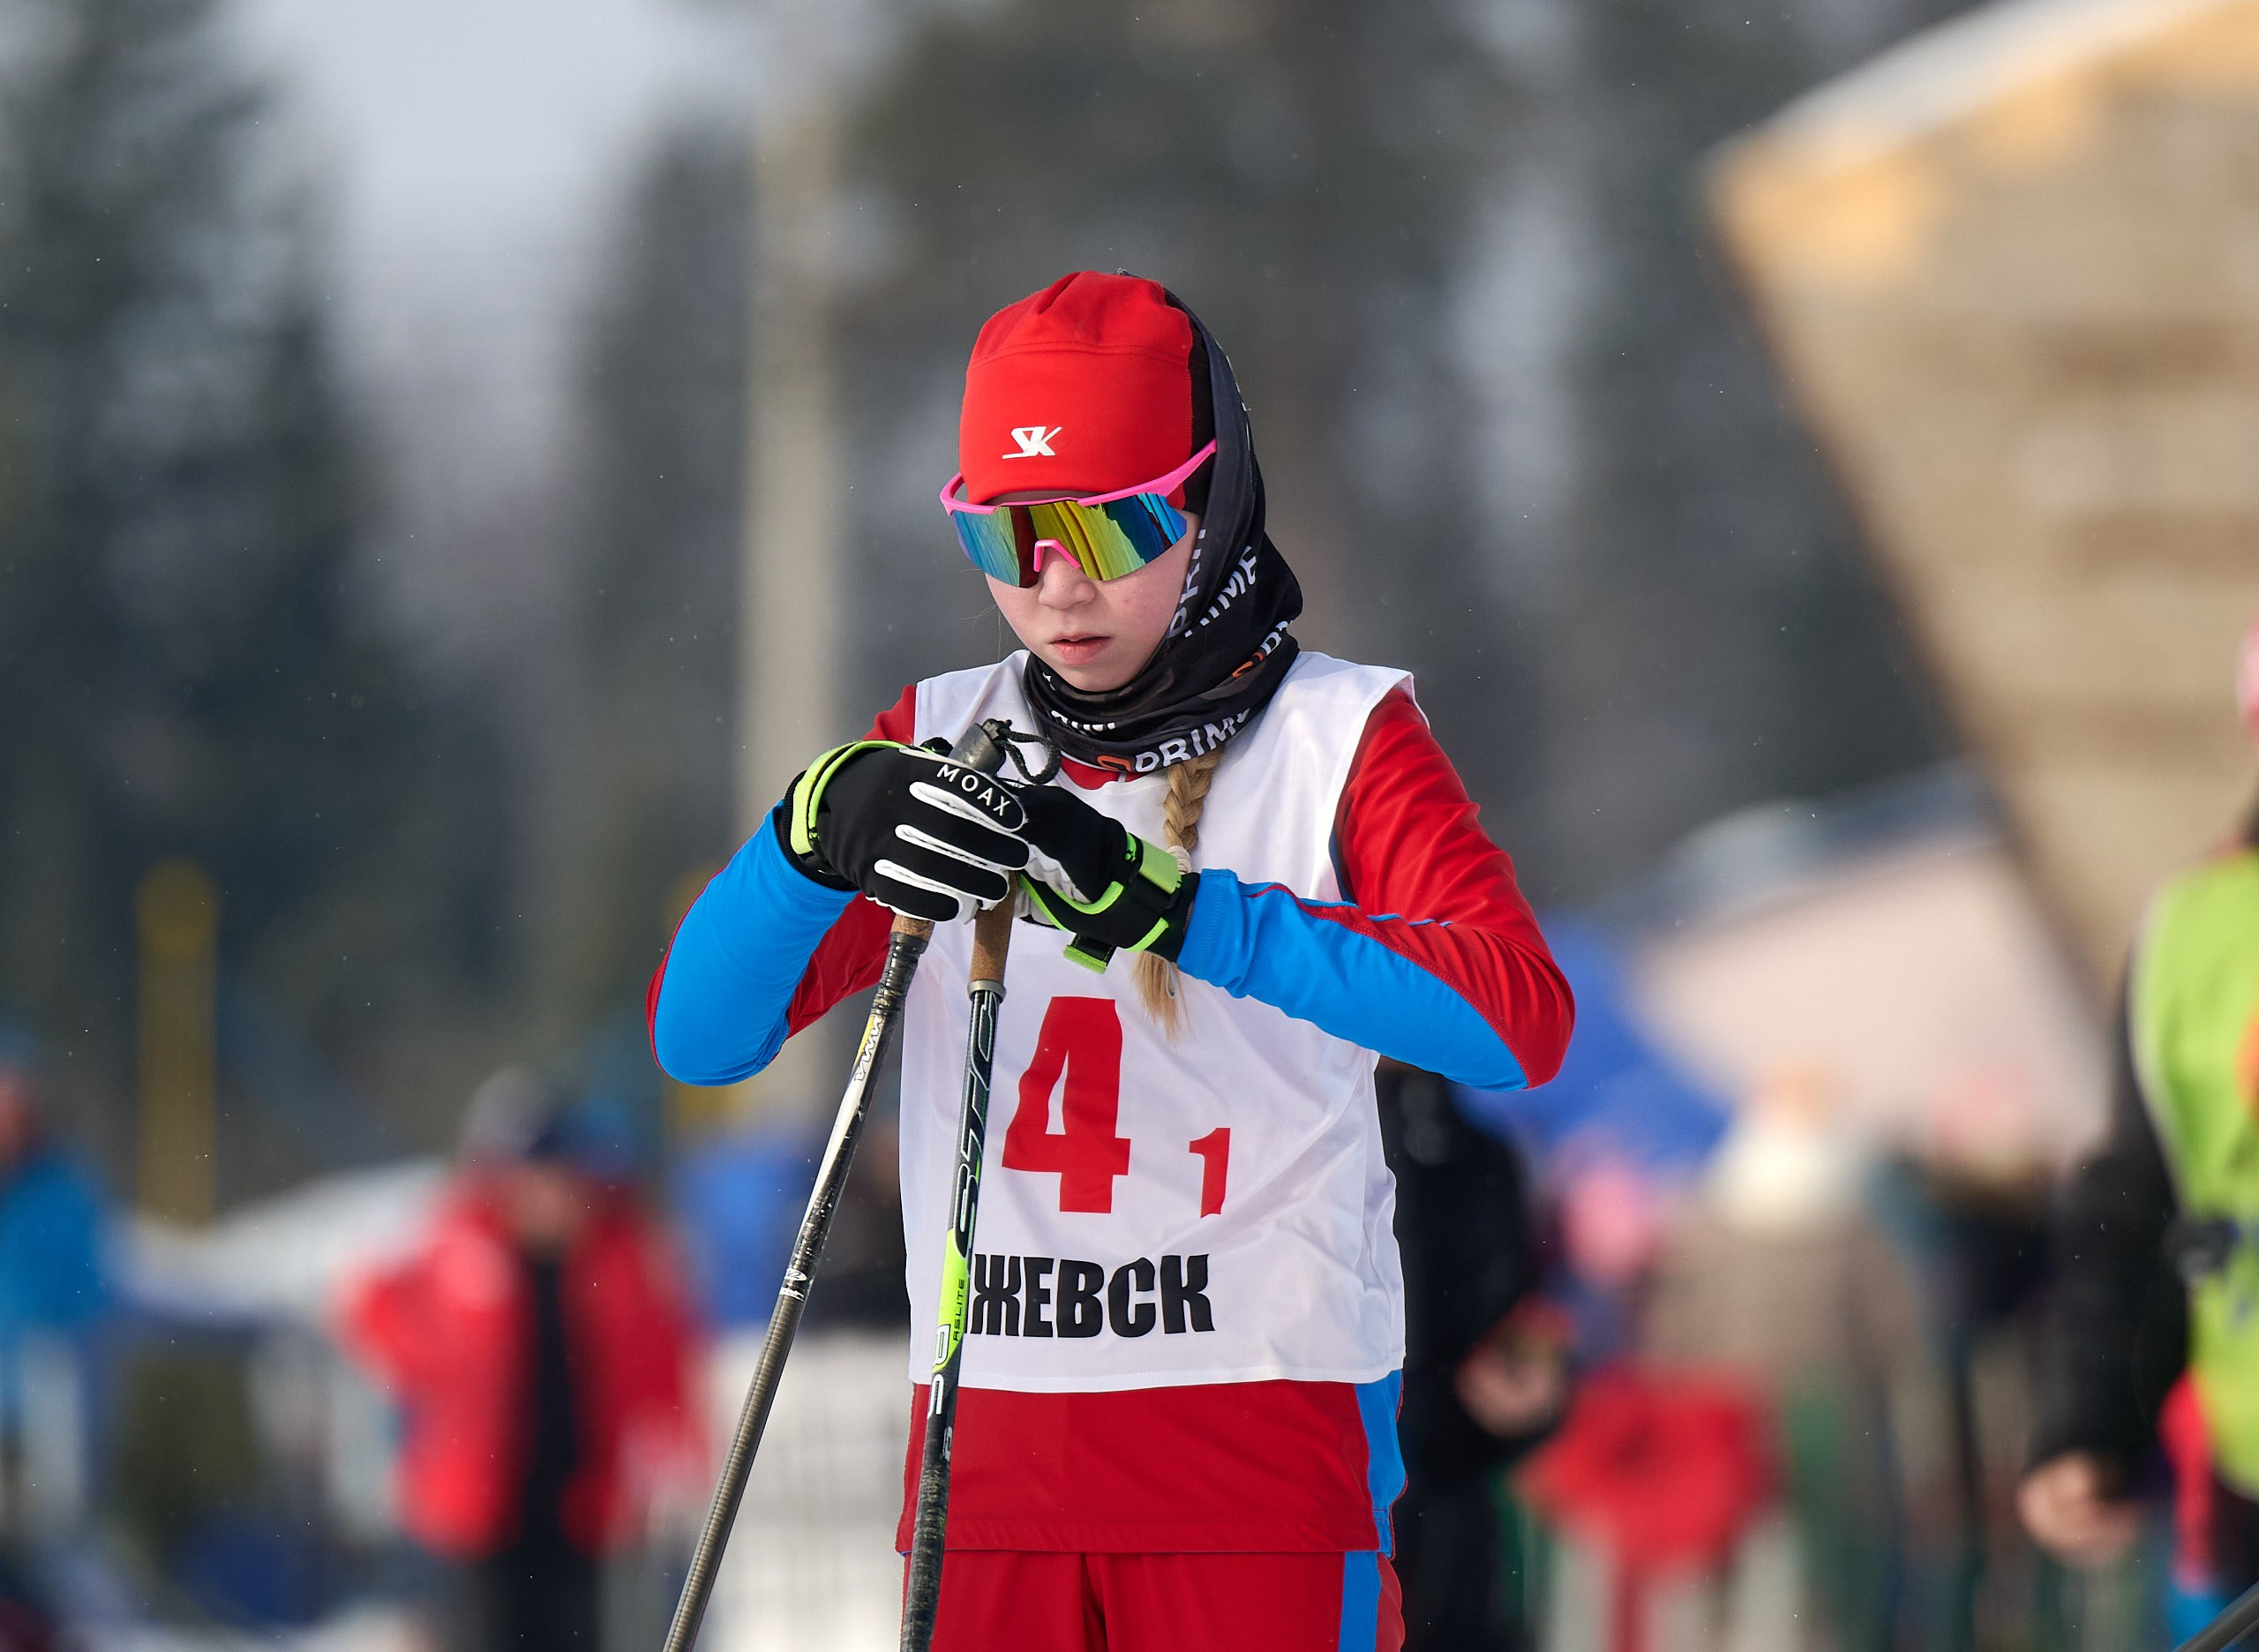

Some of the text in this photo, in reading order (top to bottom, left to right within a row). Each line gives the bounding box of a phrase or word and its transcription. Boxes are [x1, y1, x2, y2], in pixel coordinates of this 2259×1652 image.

[936, 764, 1011, 817] MOAX
[1002, 996, 1131, 1214] 4
[1189, 1127, 1231, 1219] 1
[964, 1253, 1216, 1339] ЖЕВСК
